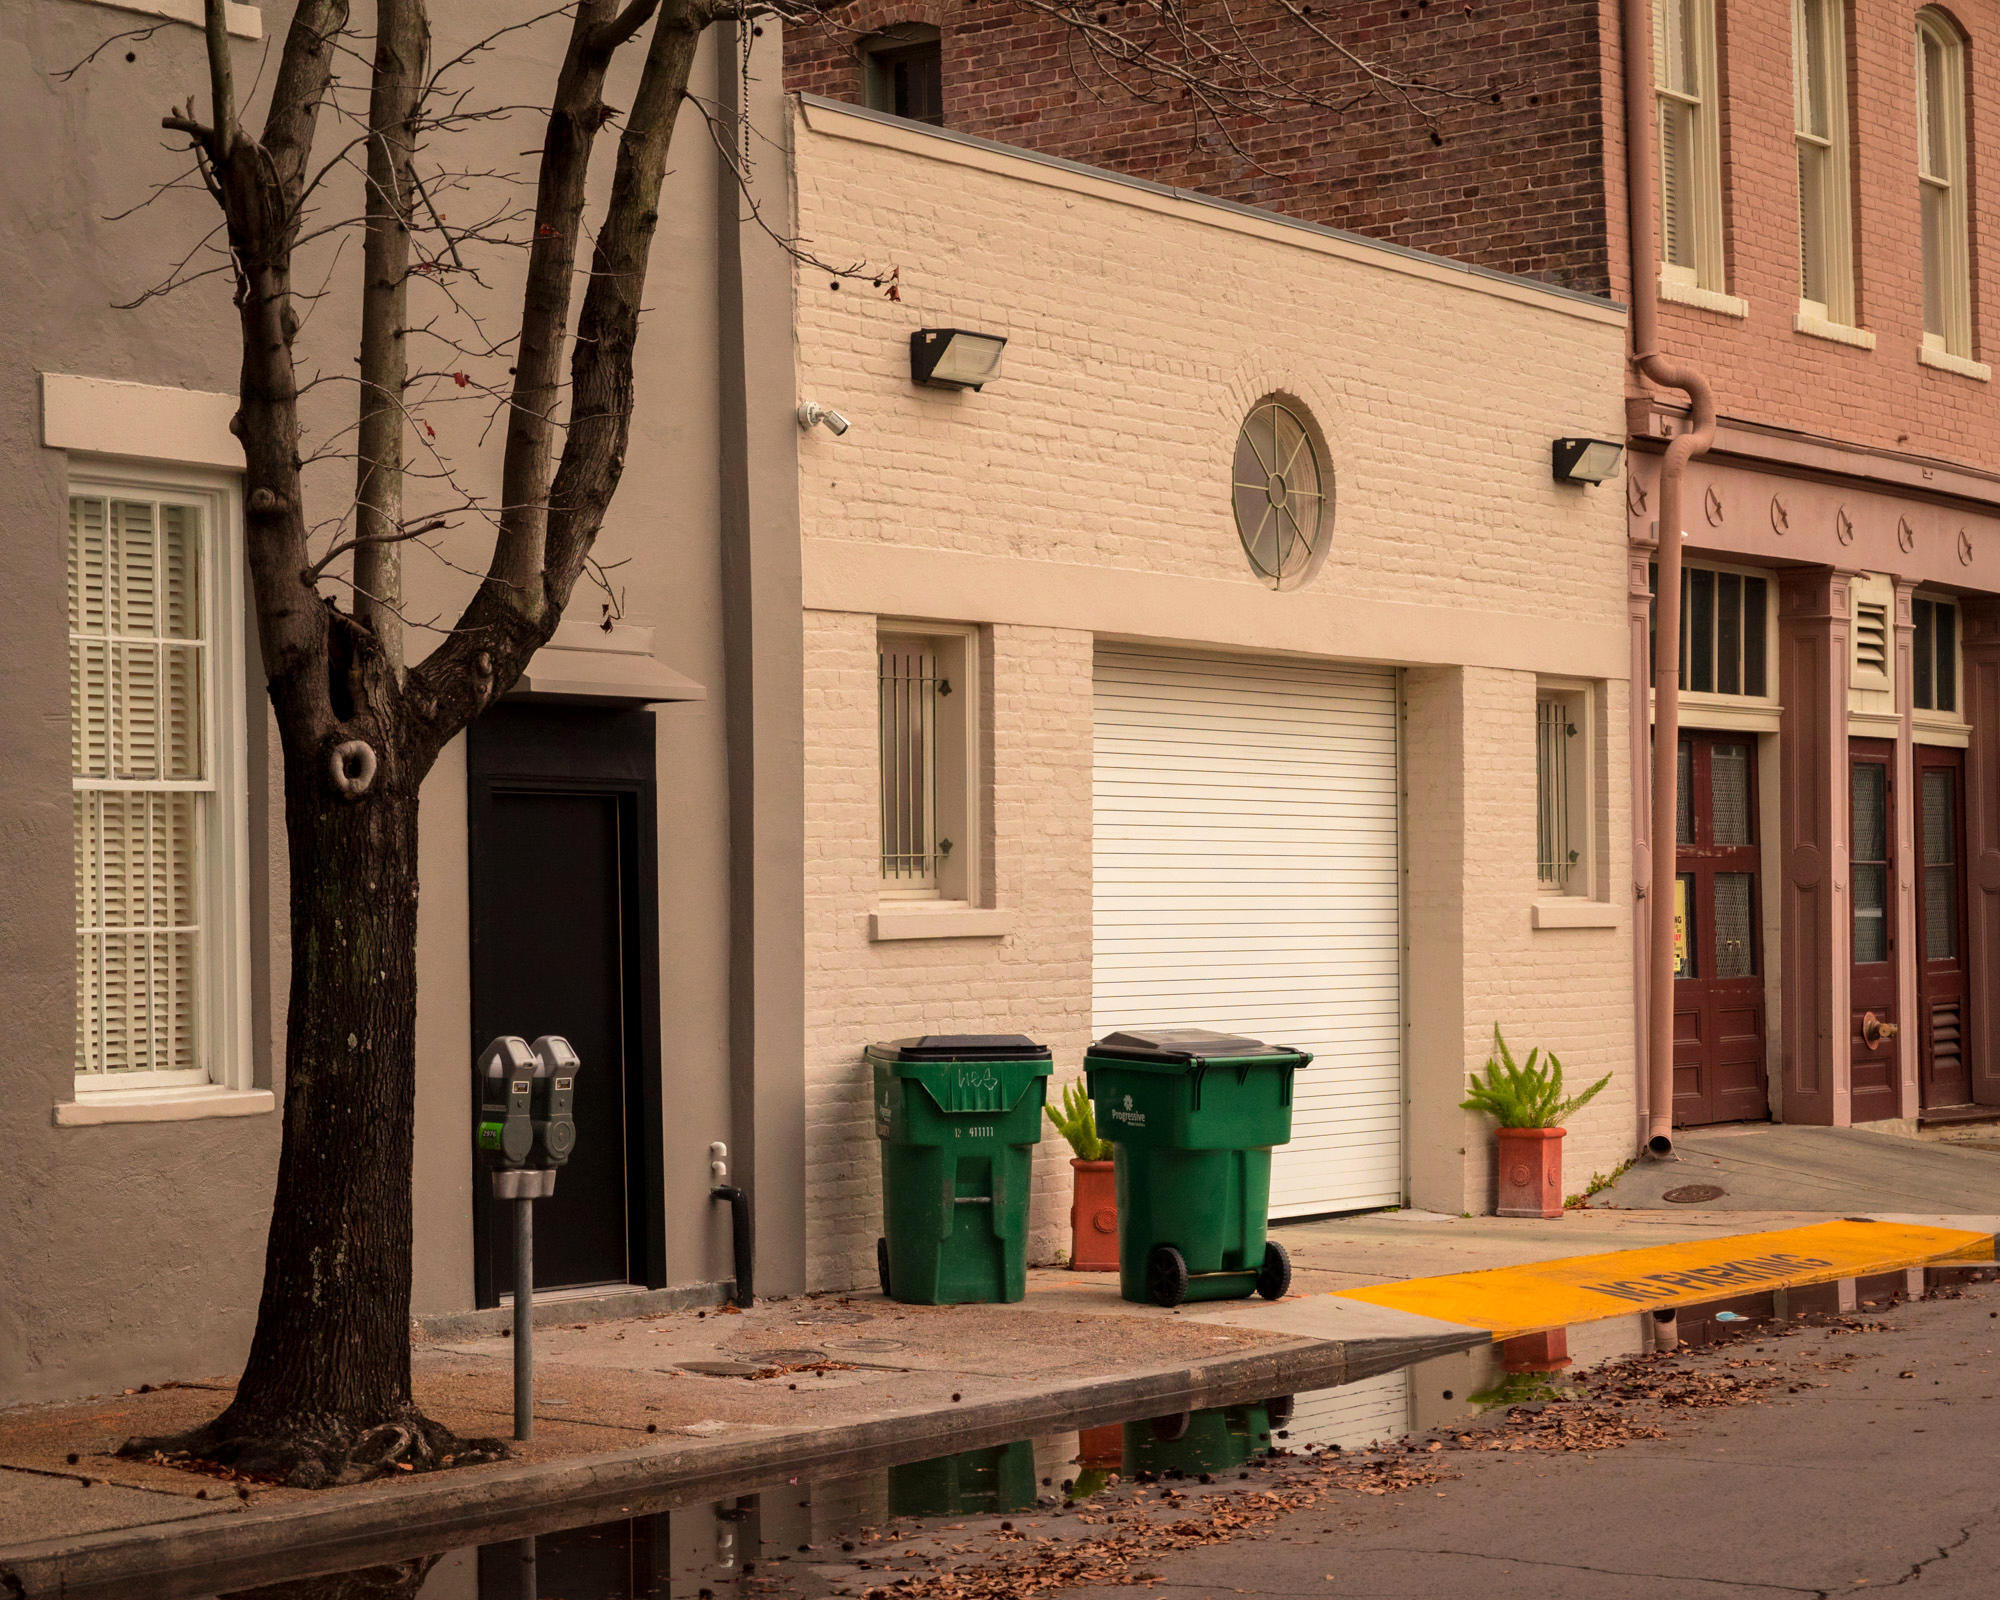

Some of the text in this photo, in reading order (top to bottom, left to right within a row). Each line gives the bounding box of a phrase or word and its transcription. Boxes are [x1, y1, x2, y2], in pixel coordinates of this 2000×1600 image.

[1111, 1108, 1146, 1123] Progressive
[483, 1130, 497, 1138] 2976
[969, 1126, 994, 1137] 411111
[1579, 1253, 1834, 1303] NO PARKING
